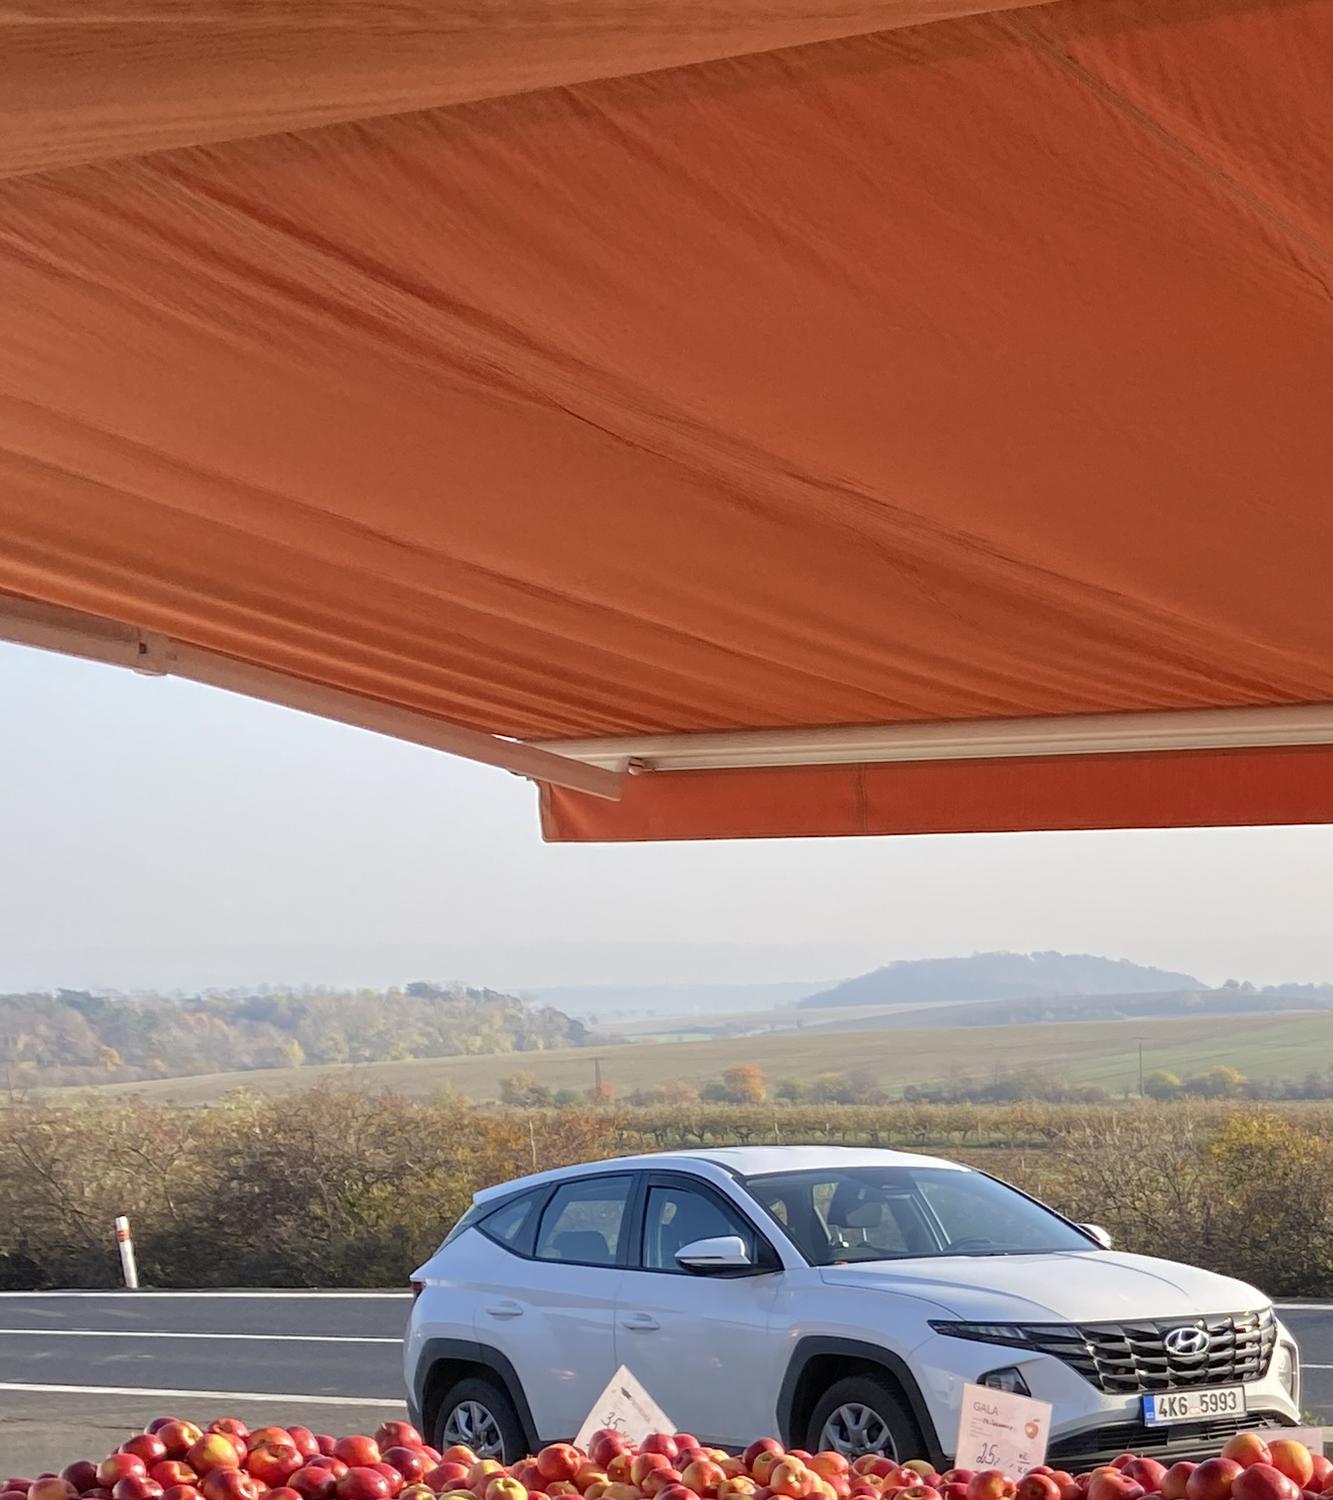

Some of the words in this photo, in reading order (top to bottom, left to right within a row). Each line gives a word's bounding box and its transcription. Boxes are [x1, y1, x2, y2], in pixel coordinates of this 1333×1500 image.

[973, 1401, 999, 1416] GALA
[1159, 1396, 1188, 1417] 4K6
[1199, 1391, 1237, 1413] 5993
